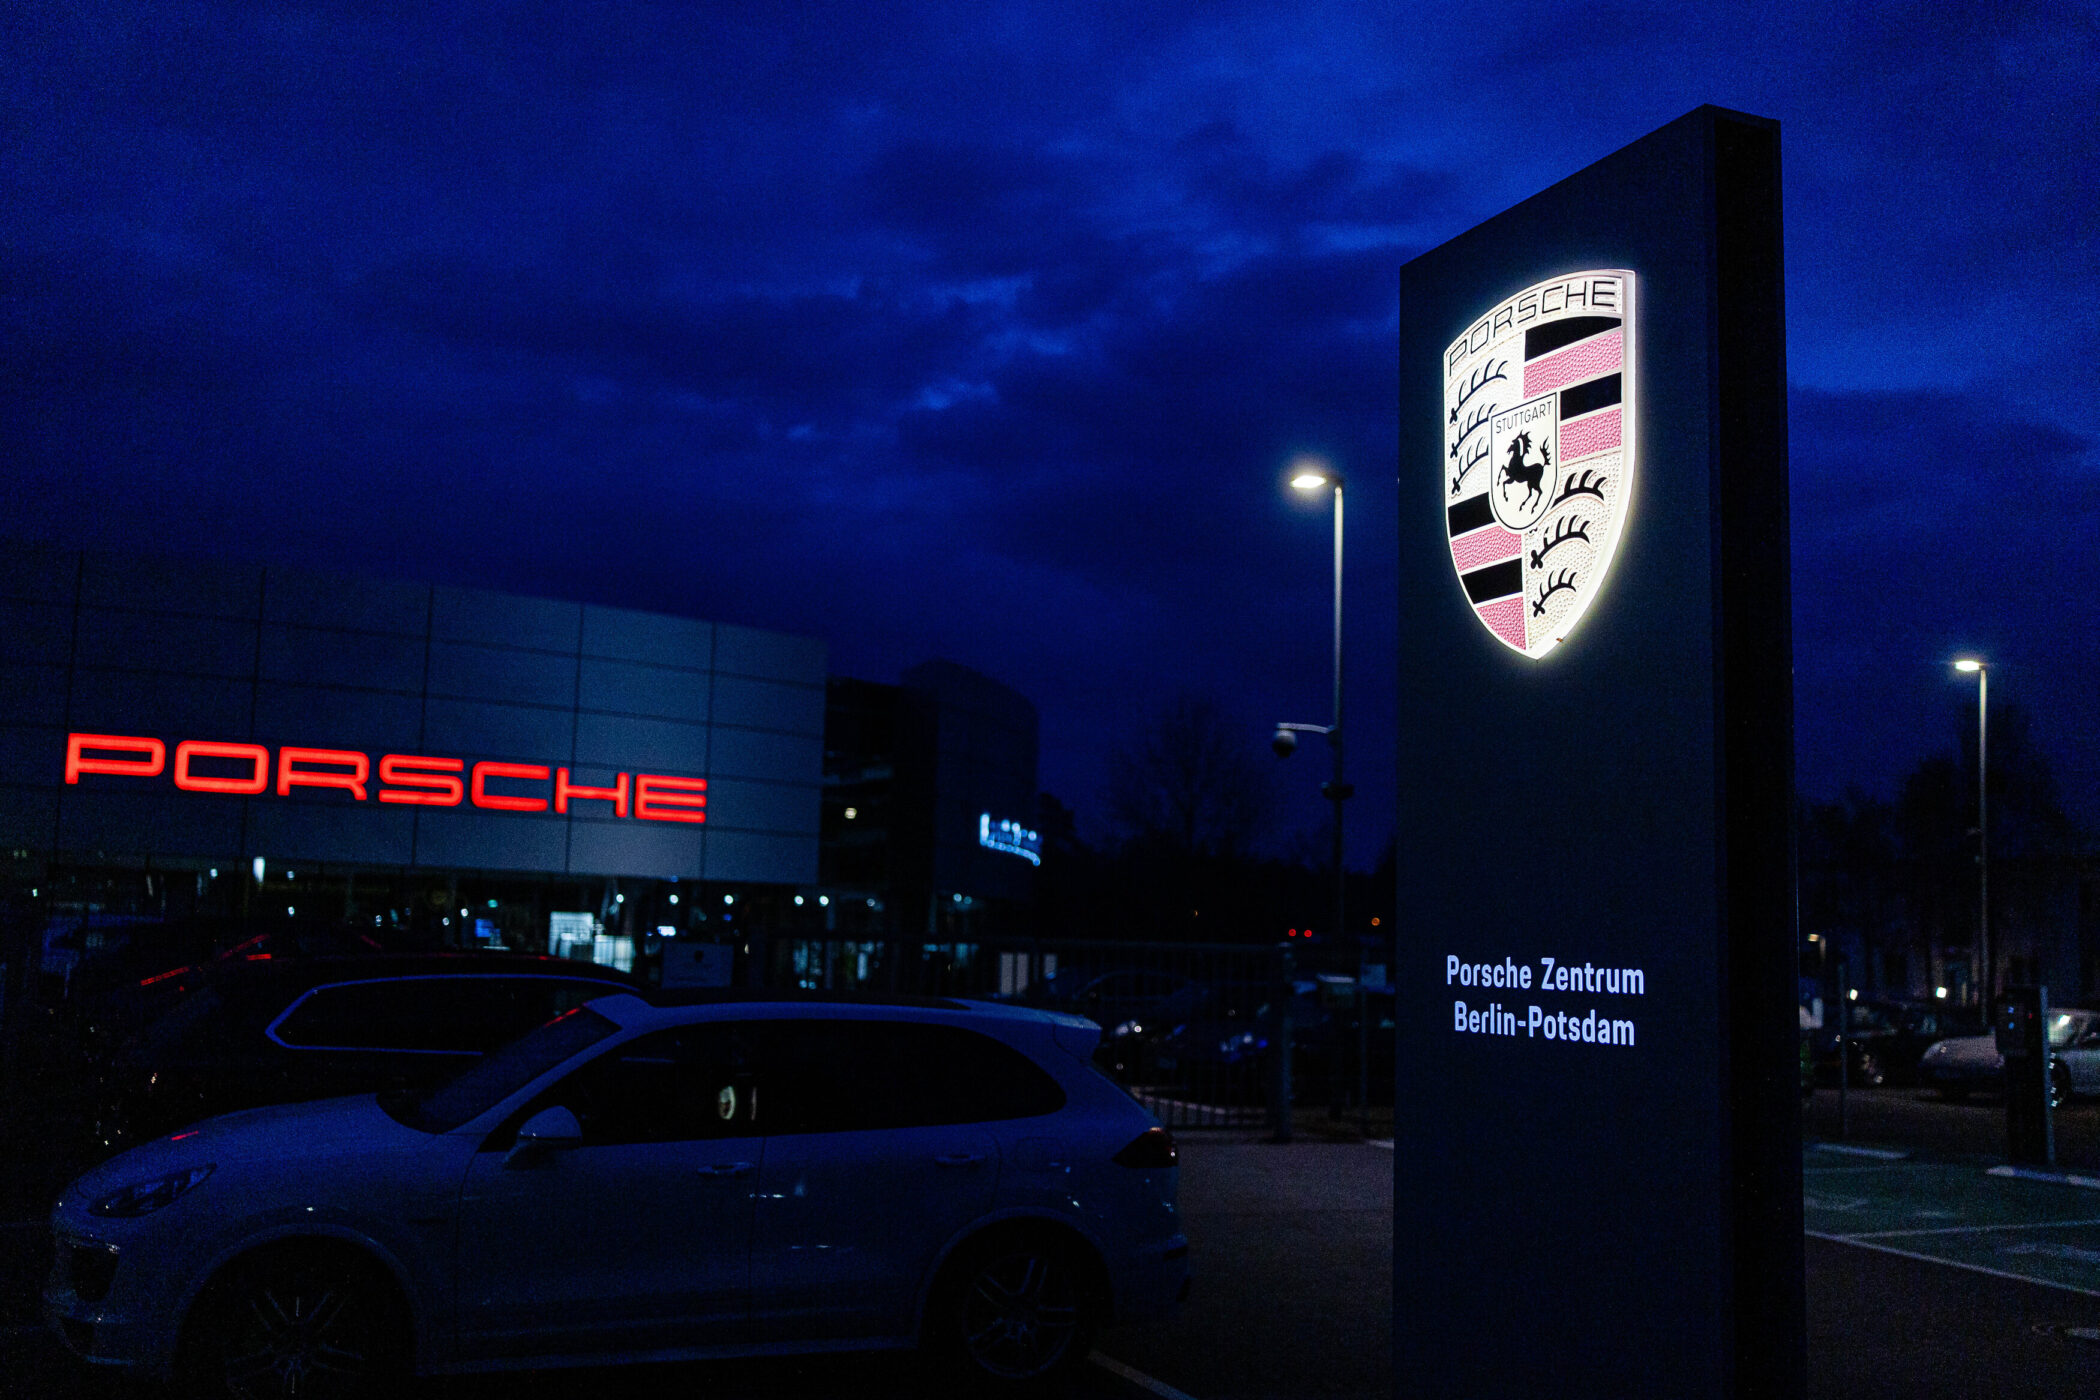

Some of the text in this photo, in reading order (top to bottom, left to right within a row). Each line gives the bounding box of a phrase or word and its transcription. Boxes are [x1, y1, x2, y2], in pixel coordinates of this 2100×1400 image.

[1449, 279, 1616, 377] PORSCHE
[1495, 401, 1553, 434] STUTTGART
[65, 732, 708, 824] PORSCHE
[1447, 955, 1644, 995] Porsche Zentrum
[1454, 1001, 1635, 1046] Berlin-Potsdam
